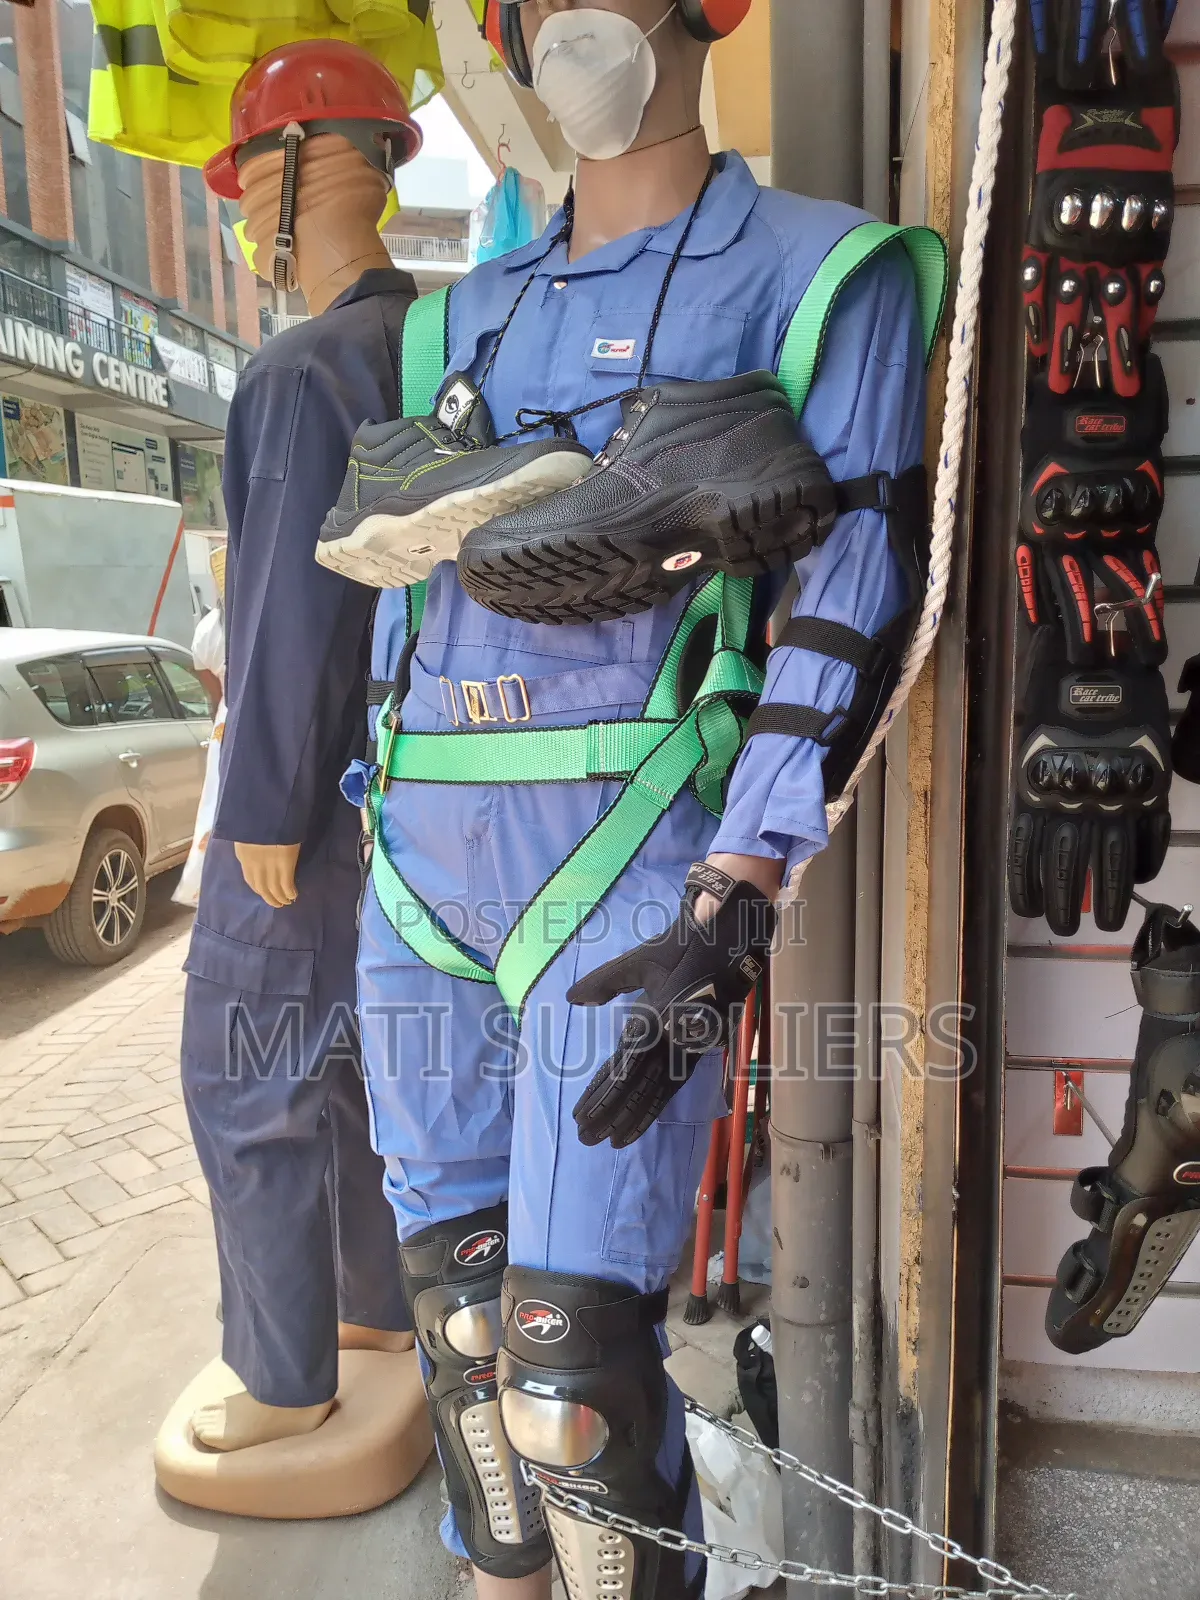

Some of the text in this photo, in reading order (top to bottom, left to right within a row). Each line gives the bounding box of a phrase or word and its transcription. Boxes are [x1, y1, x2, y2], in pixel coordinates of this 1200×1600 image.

[92, 352, 169, 408] CENTRE
[1072, 687, 1098, 696] Race
[1096, 694, 1120, 702] tribe
[520, 1311, 564, 1327] PRO-BIKER
